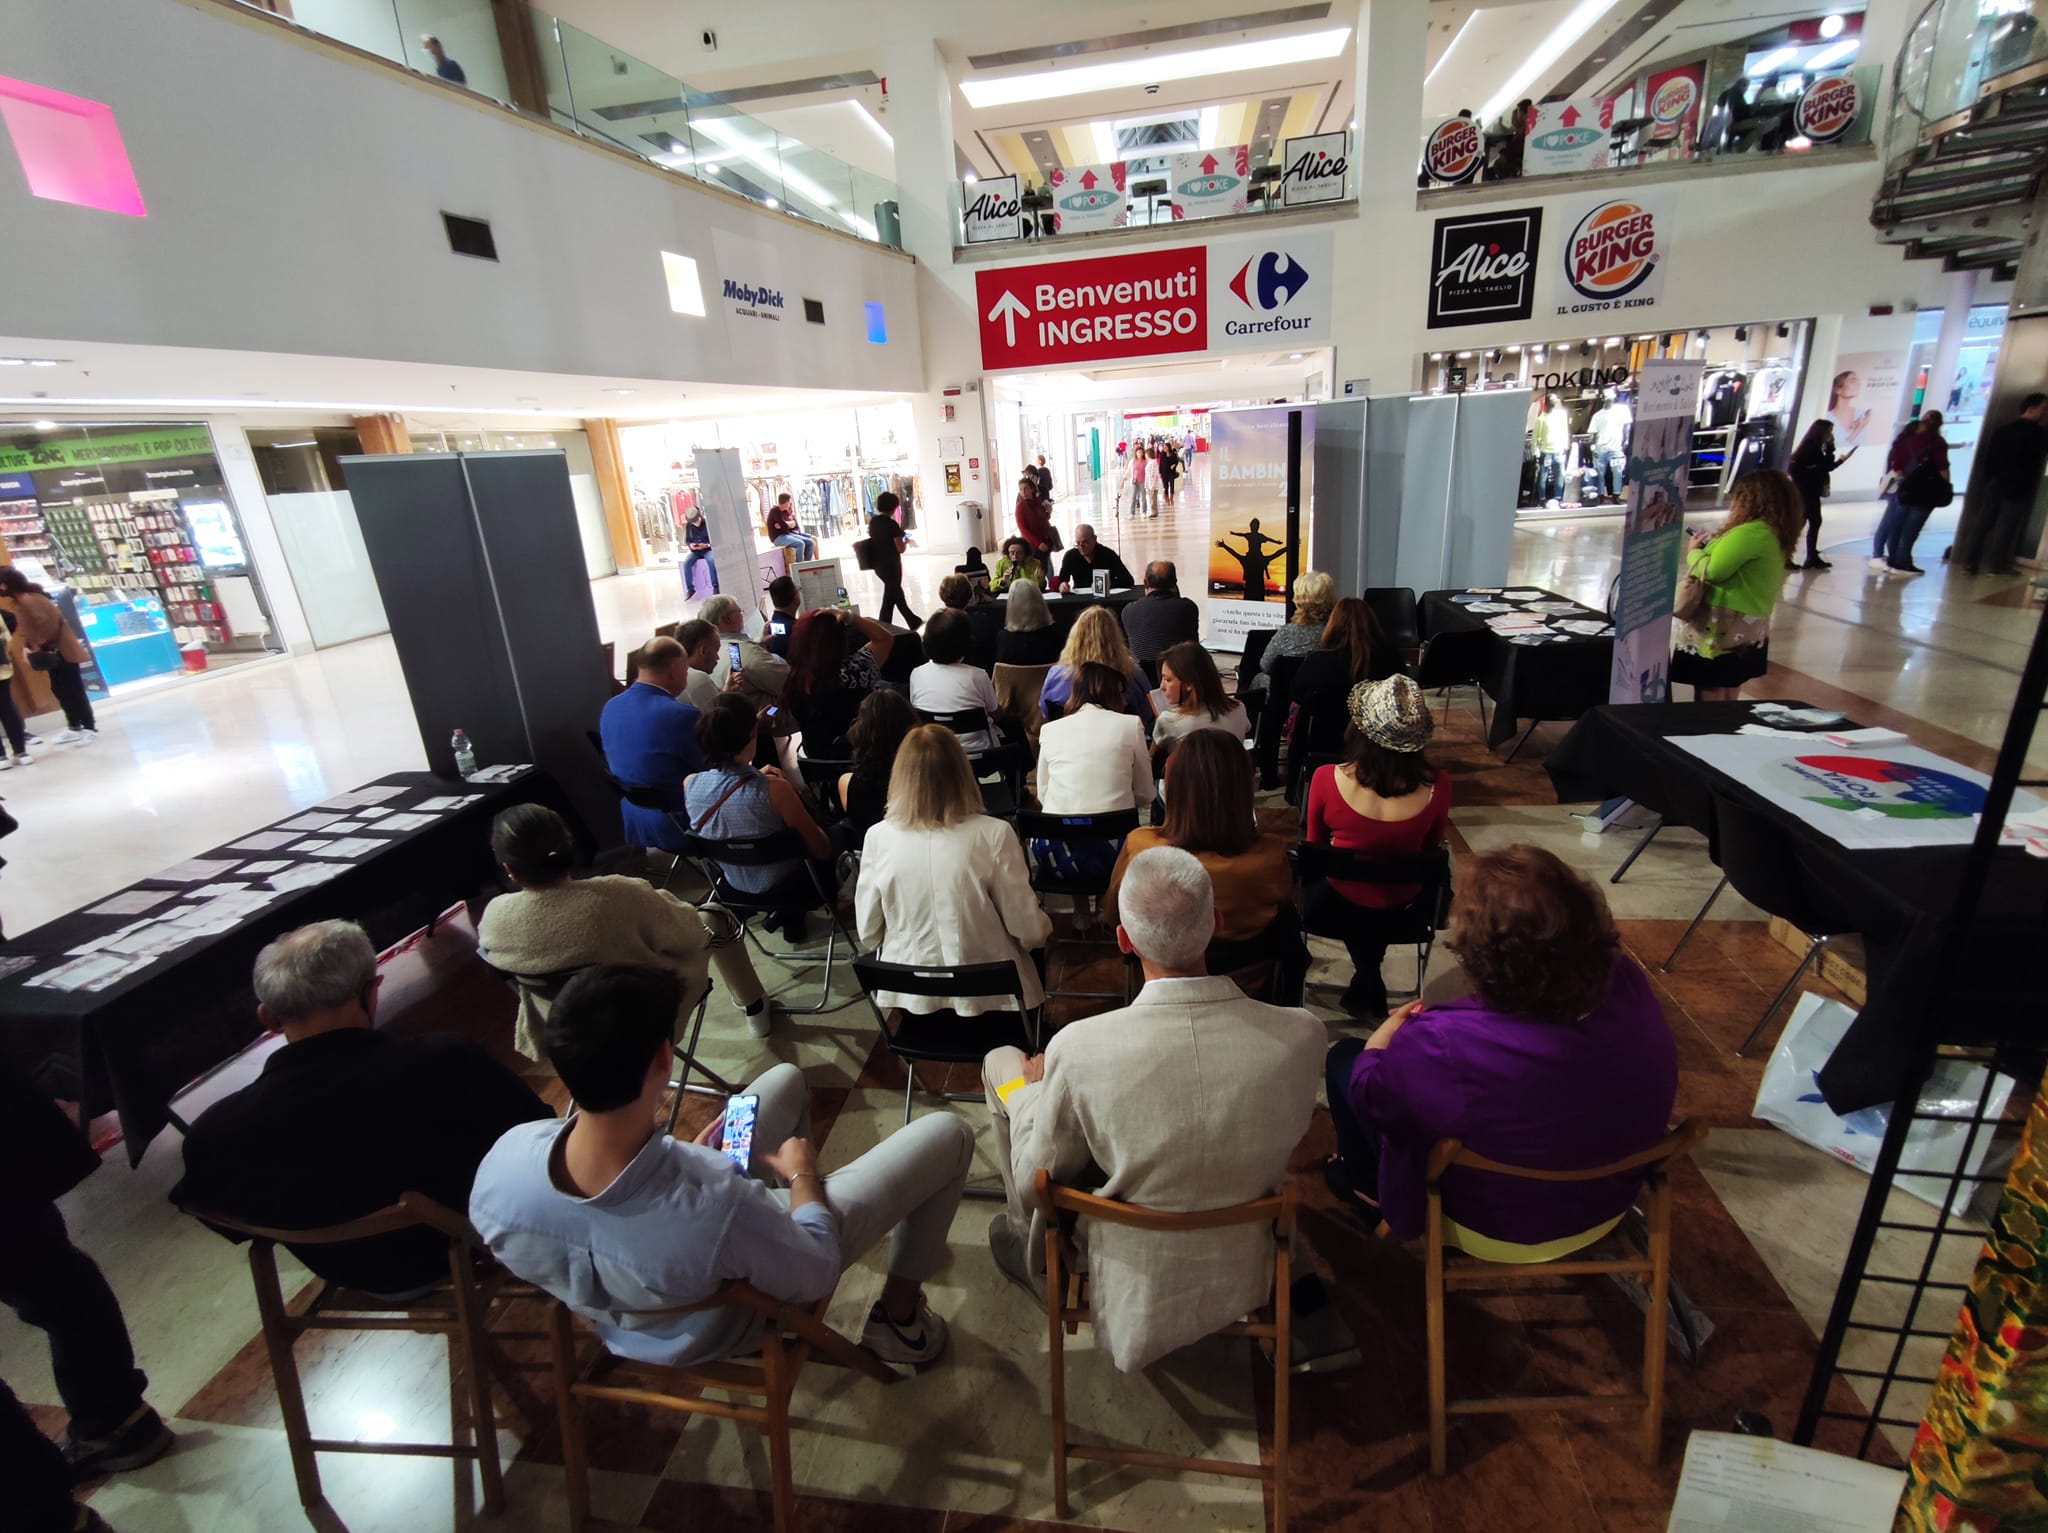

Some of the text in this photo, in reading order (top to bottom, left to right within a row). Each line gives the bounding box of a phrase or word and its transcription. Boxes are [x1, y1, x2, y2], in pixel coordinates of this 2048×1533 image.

[1658, 92, 1690, 116] KING
[1659, 82, 1690, 107] BURGER
[1803, 83, 1855, 112] BURGER
[1803, 96, 1855, 130] KING
[1432, 126, 1476, 157] BURGER
[1433, 137, 1478, 174] KING
[1281, 151, 1349, 184] Alice
[963, 193, 1021, 224] Alice
[1574, 213, 1654, 258] BURGER
[1434, 243, 1531, 287] Alice
[1574, 231, 1655, 284] KING
[1035, 266, 1197, 312] Benvenuti
[1485, 284, 1512, 292] TAGLIO
[1557, 306, 1568, 315] IL
[1571, 301, 1611, 313] GUSTO
[1624, 297, 1654, 309] KING
[1038, 307, 1197, 348] INGRESSO
[1225, 315, 1312, 336] Carrefour
[1531, 366, 1629, 391] TOKUNO
[1219, 463, 1287, 480] BAMBIN
[1823, 772, 1882, 798] ROMA
